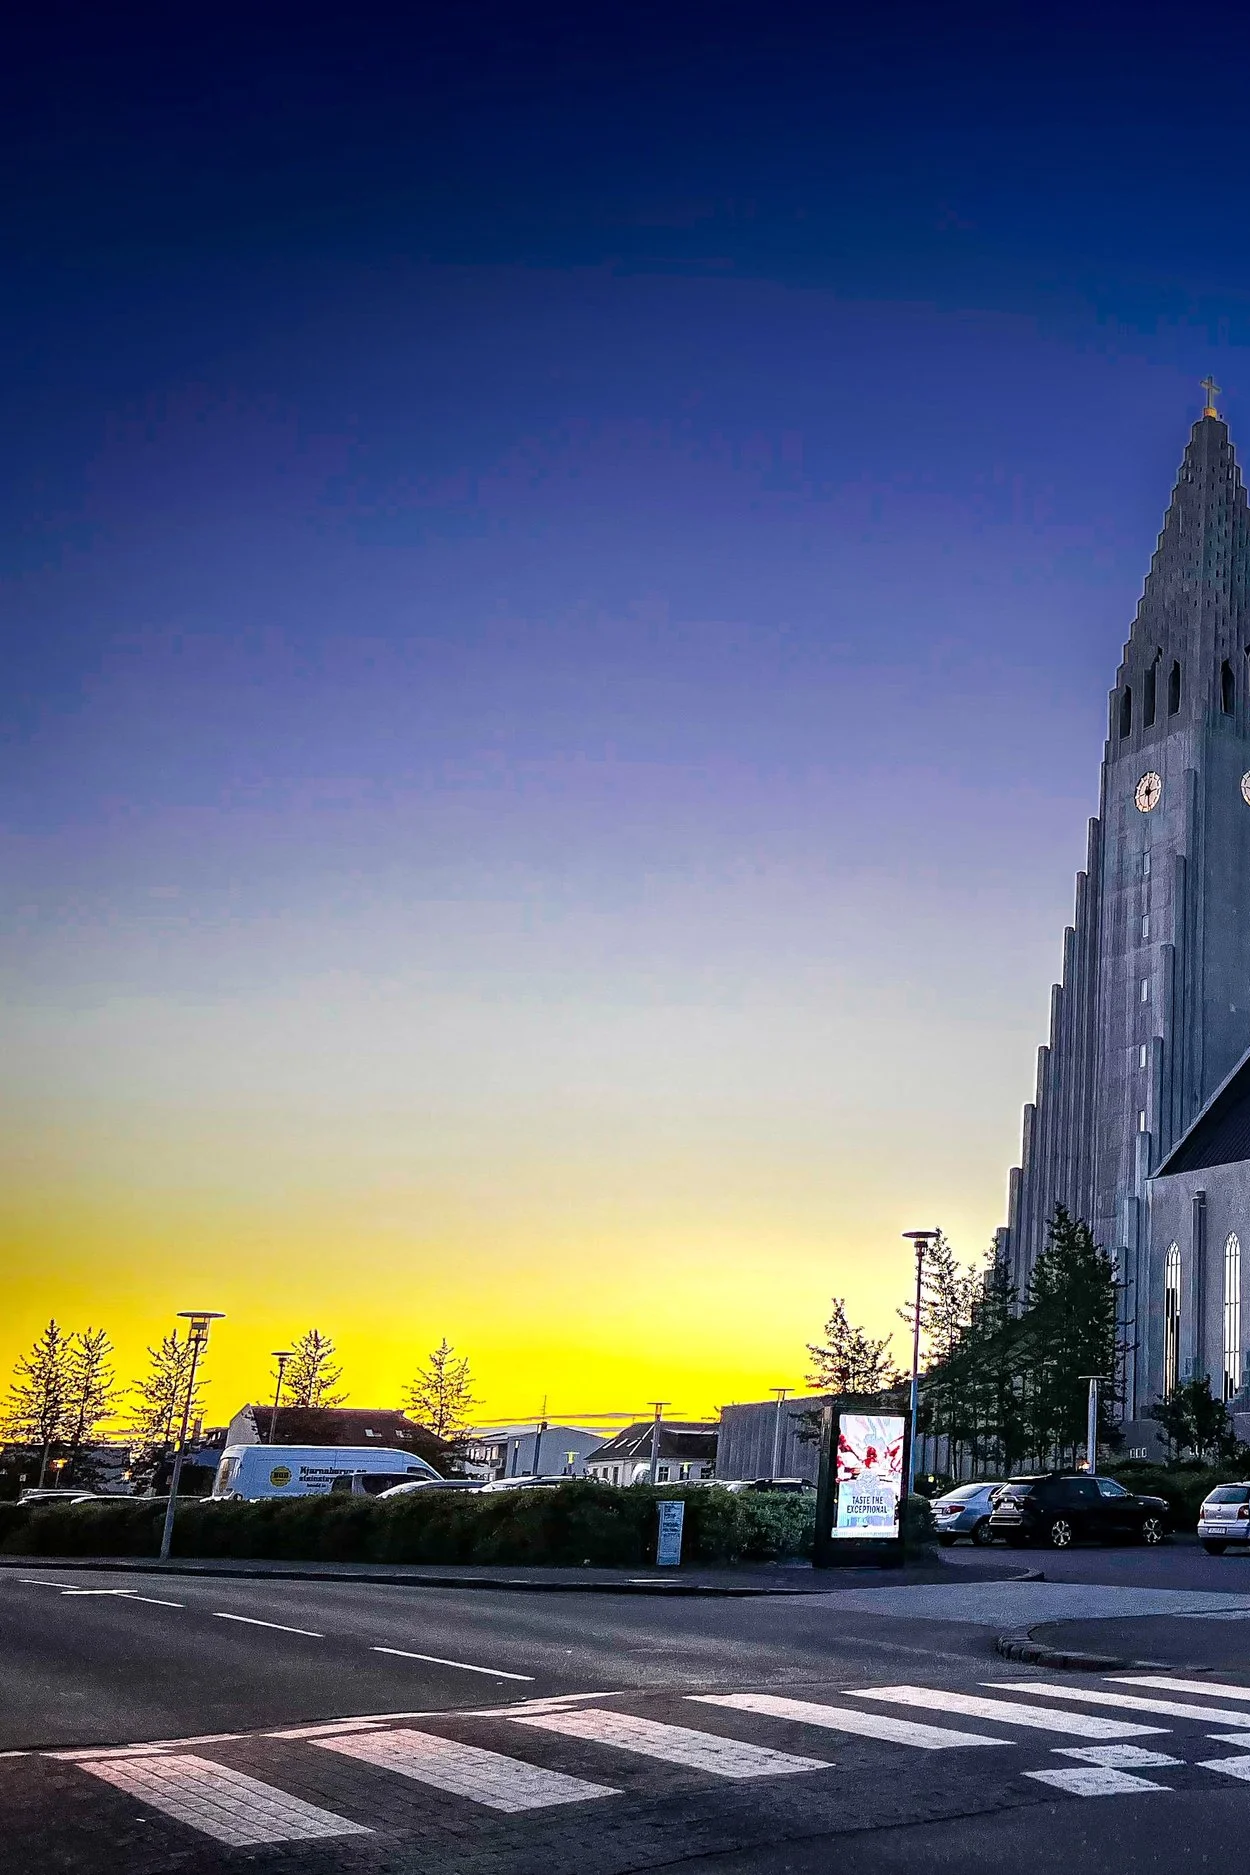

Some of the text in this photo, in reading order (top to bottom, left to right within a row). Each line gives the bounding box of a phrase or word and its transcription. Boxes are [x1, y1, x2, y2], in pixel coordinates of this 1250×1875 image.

[852, 1496, 883, 1504] TASTE THE
[846, 1505, 887, 1513] EXCEPTIONAL
